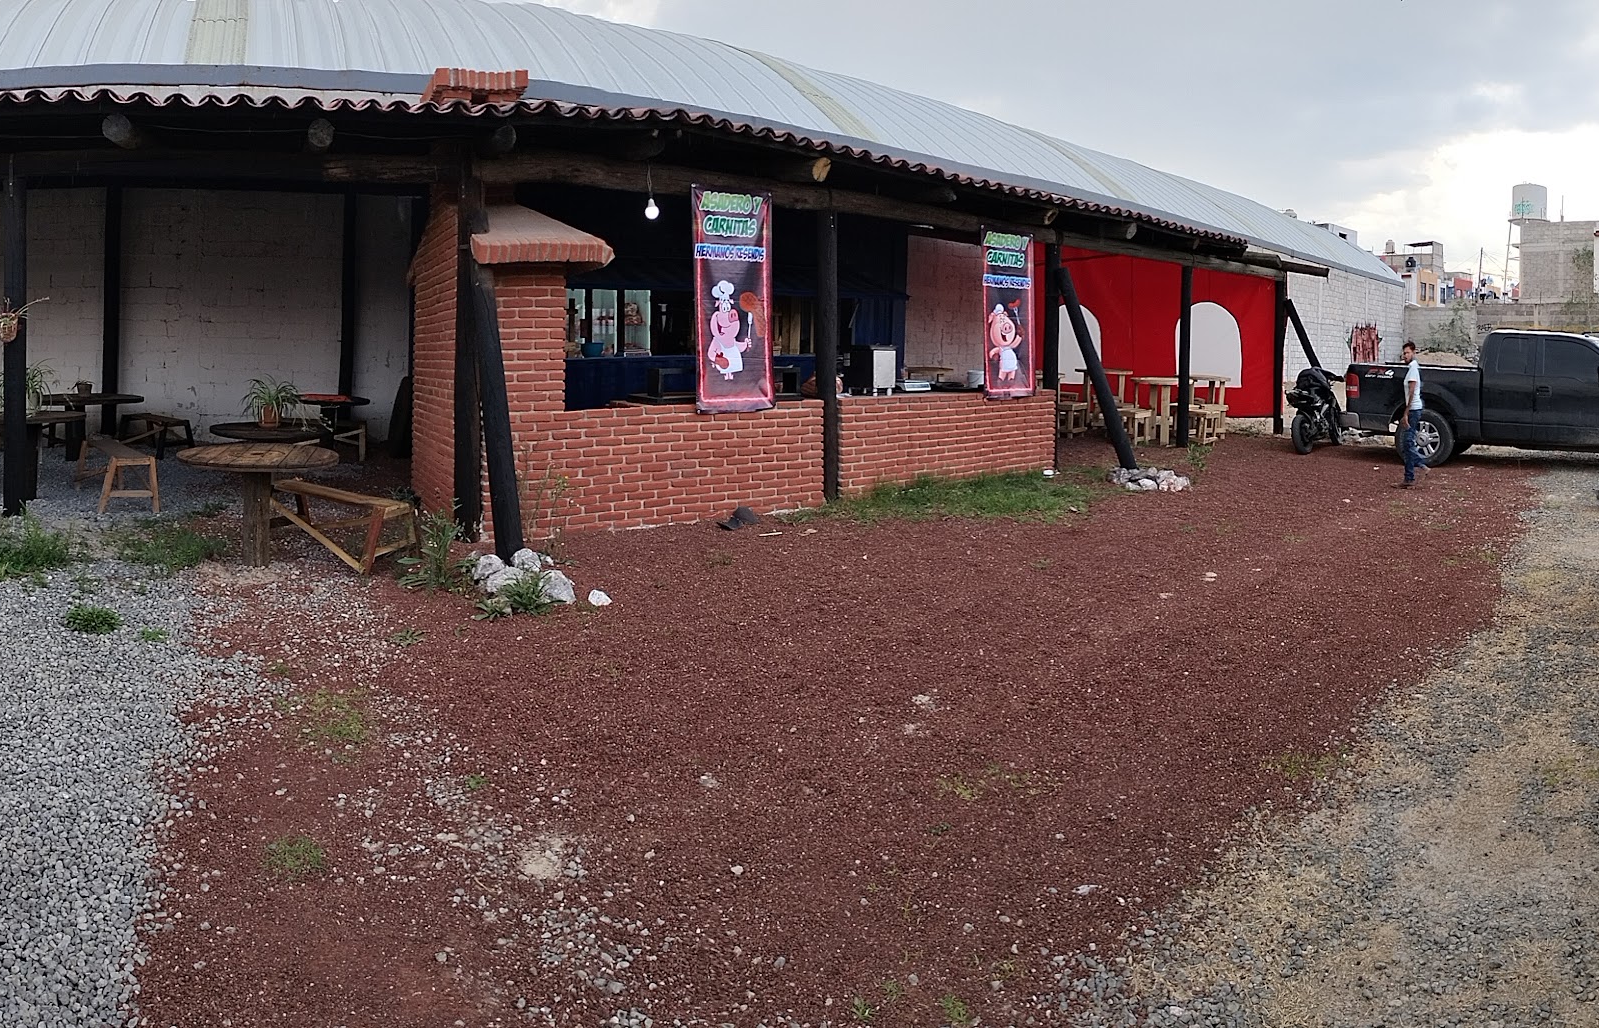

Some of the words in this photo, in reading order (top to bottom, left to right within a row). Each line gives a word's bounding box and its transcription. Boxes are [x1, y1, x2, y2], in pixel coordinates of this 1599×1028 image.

[699, 191, 752, 214] ASADERO
[753, 196, 763, 215] Y
[703, 215, 757, 238] CARNITAS
[983, 231, 1021, 250] ASADERO
[1021, 236, 1029, 250] Y
[695, 244, 734, 260] HERMANOS
[734, 246, 766, 262] RESENDIS
[986, 249, 1025, 268] CARNITAS
